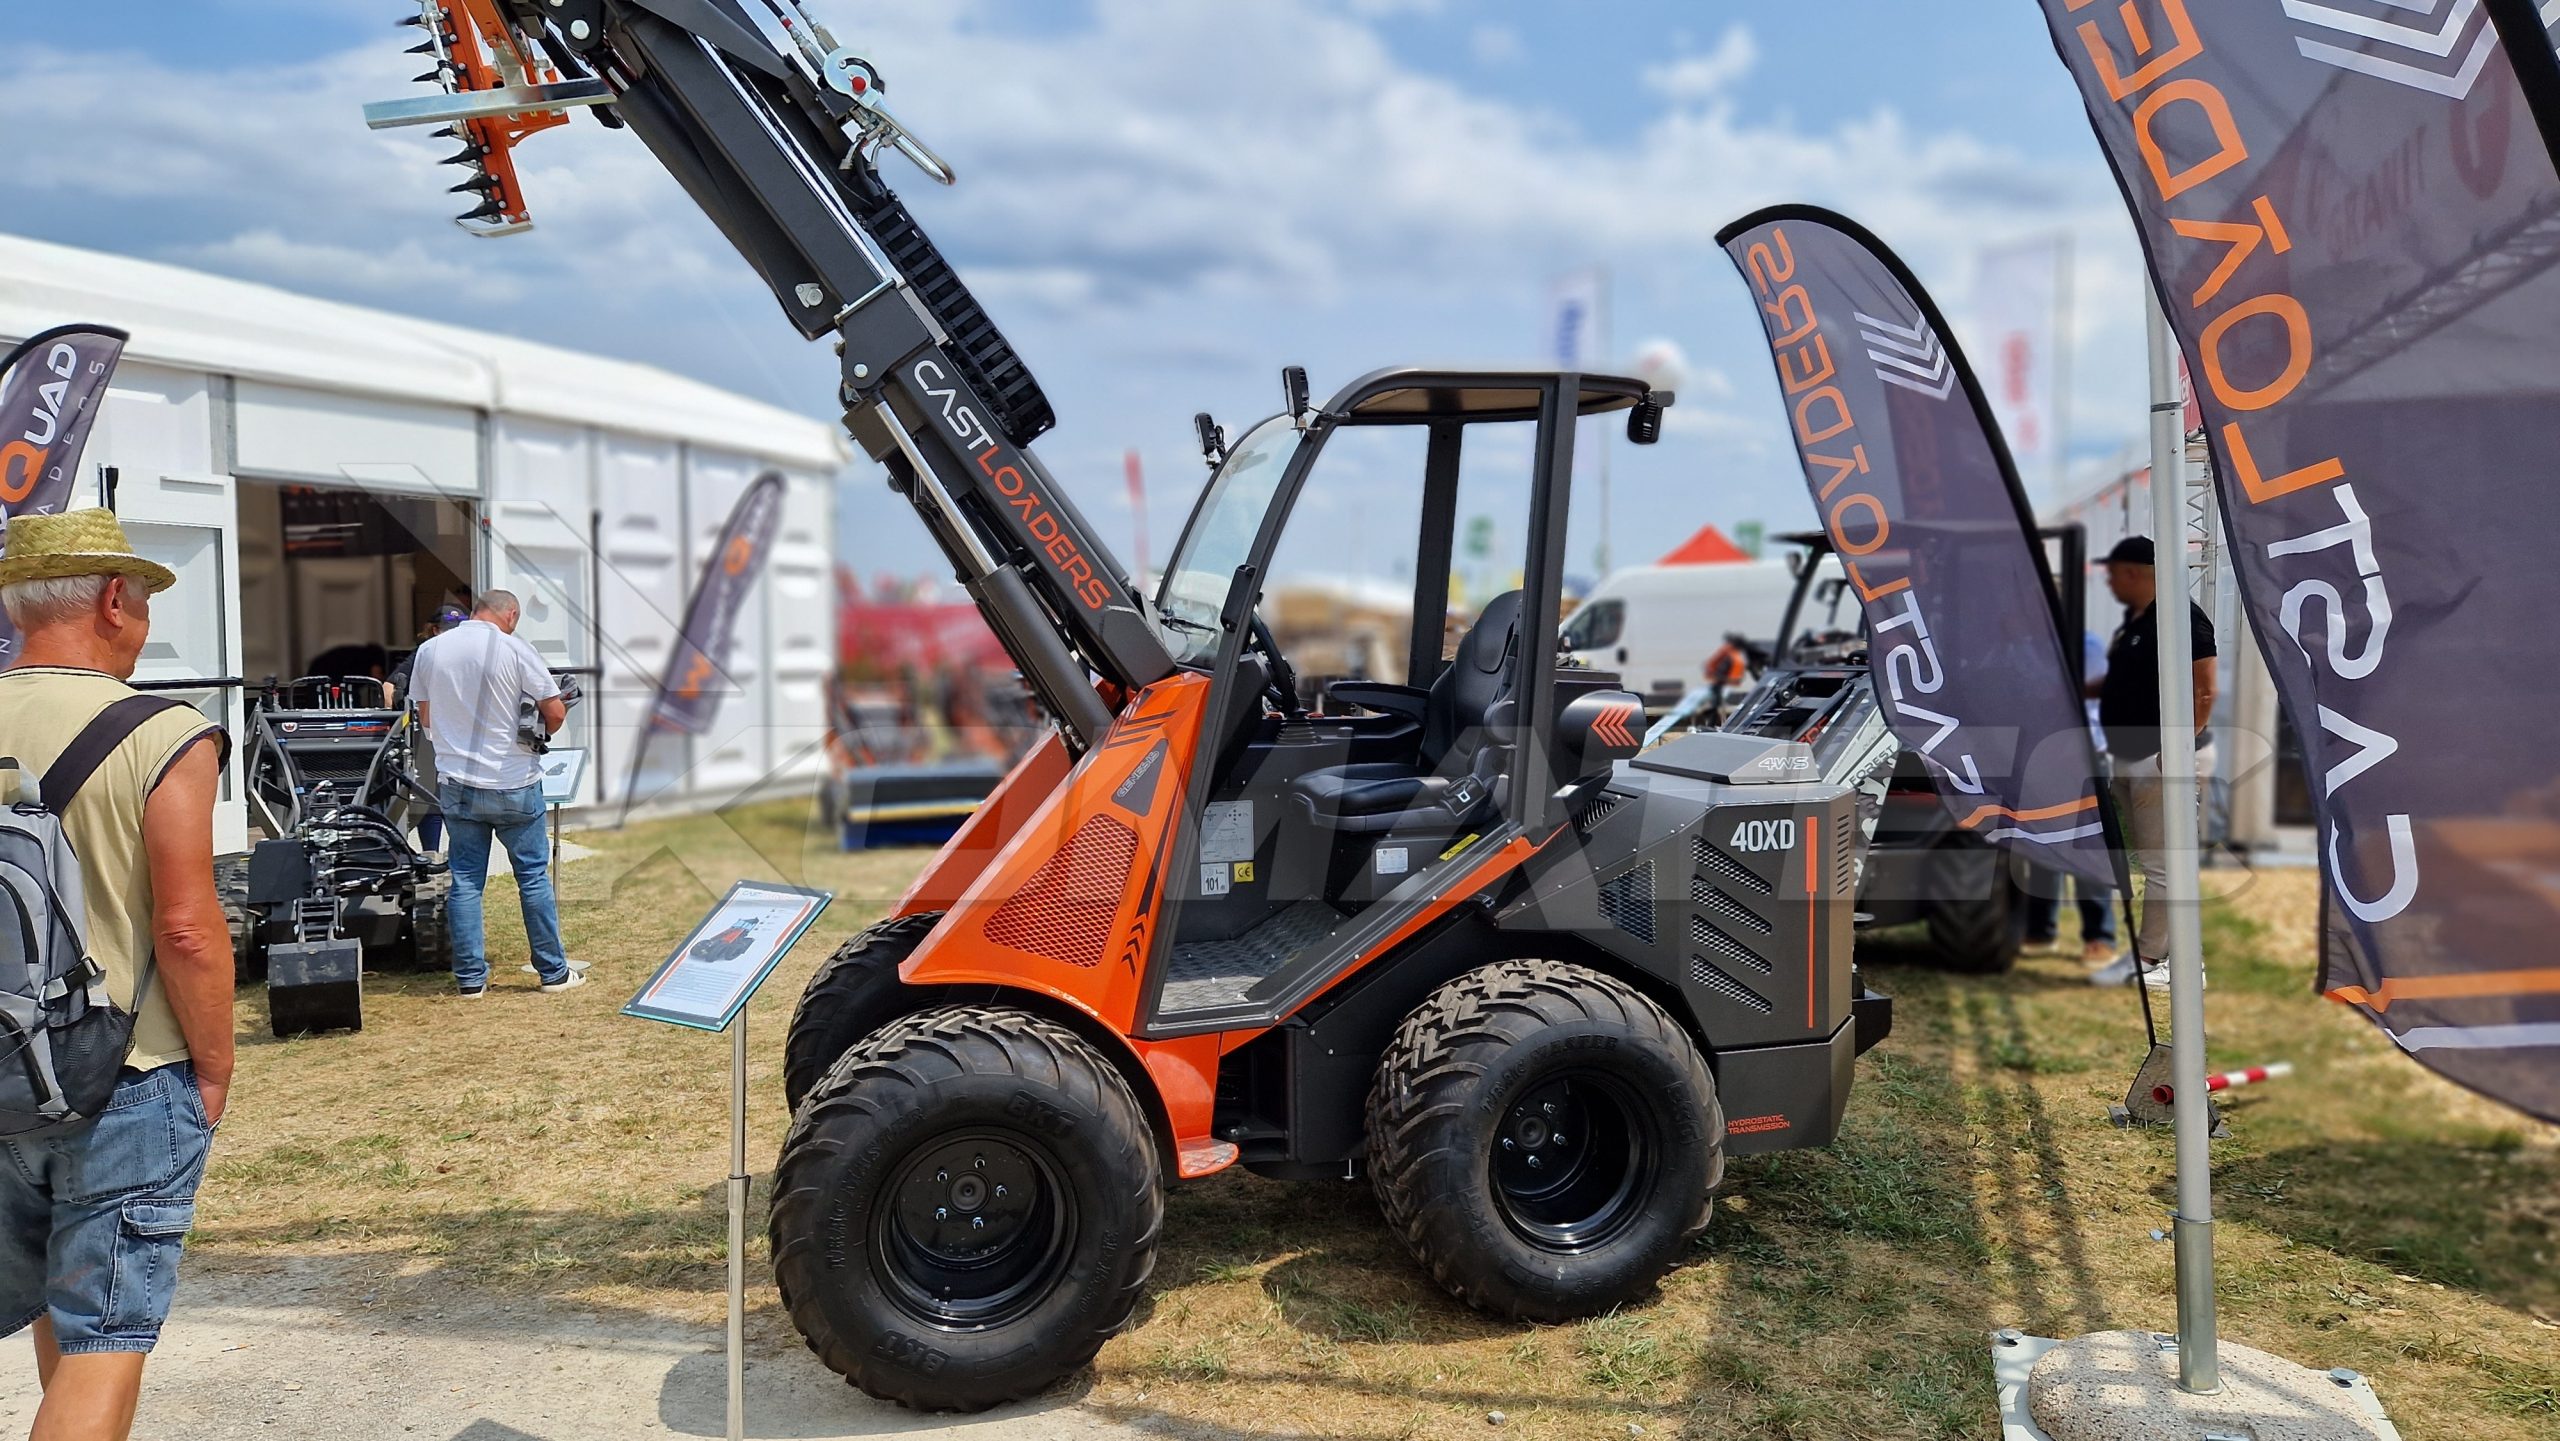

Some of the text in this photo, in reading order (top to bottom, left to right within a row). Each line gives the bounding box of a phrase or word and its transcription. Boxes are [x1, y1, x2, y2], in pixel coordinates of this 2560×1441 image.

[0, 343, 77, 531] QUAD
[914, 360, 1112, 609] CASTLOADERS
[1116, 750, 1160, 798] GENESIS
[1758, 756, 1810, 771] 4WS
[1848, 744, 1895, 788] FOREST
[1730, 818, 1796, 852] 40XD
[1205, 876, 1220, 891] 101
[1727, 1113, 1784, 1127] HYDROSTATIC
[1727, 1120, 1790, 1135] TRANSMISSION
